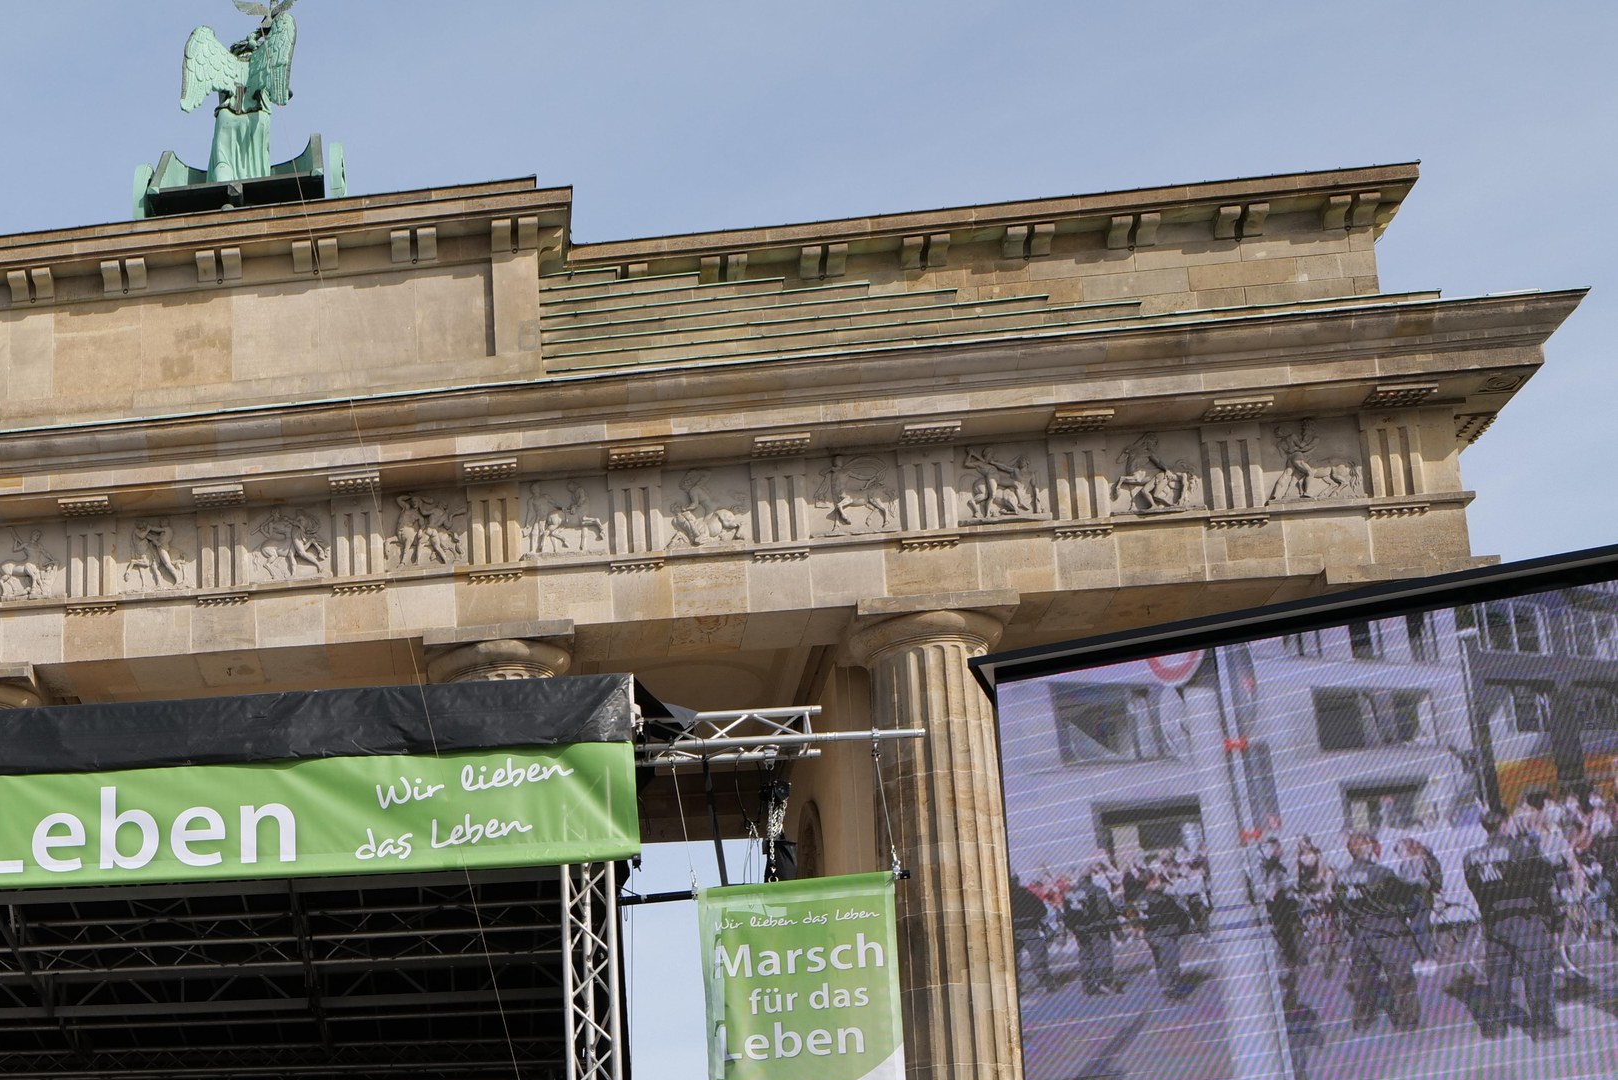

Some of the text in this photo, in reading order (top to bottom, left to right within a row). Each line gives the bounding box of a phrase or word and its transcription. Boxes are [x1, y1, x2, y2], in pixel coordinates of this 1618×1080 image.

[376, 758, 574, 809] Wir lieben
[355, 813, 532, 859] das Leben
[714, 908, 880, 931] Wir lieben das Leben
[713, 933, 884, 979] Marsch
[749, 983, 870, 1015] für das
[720, 1022, 865, 1061] Leben
